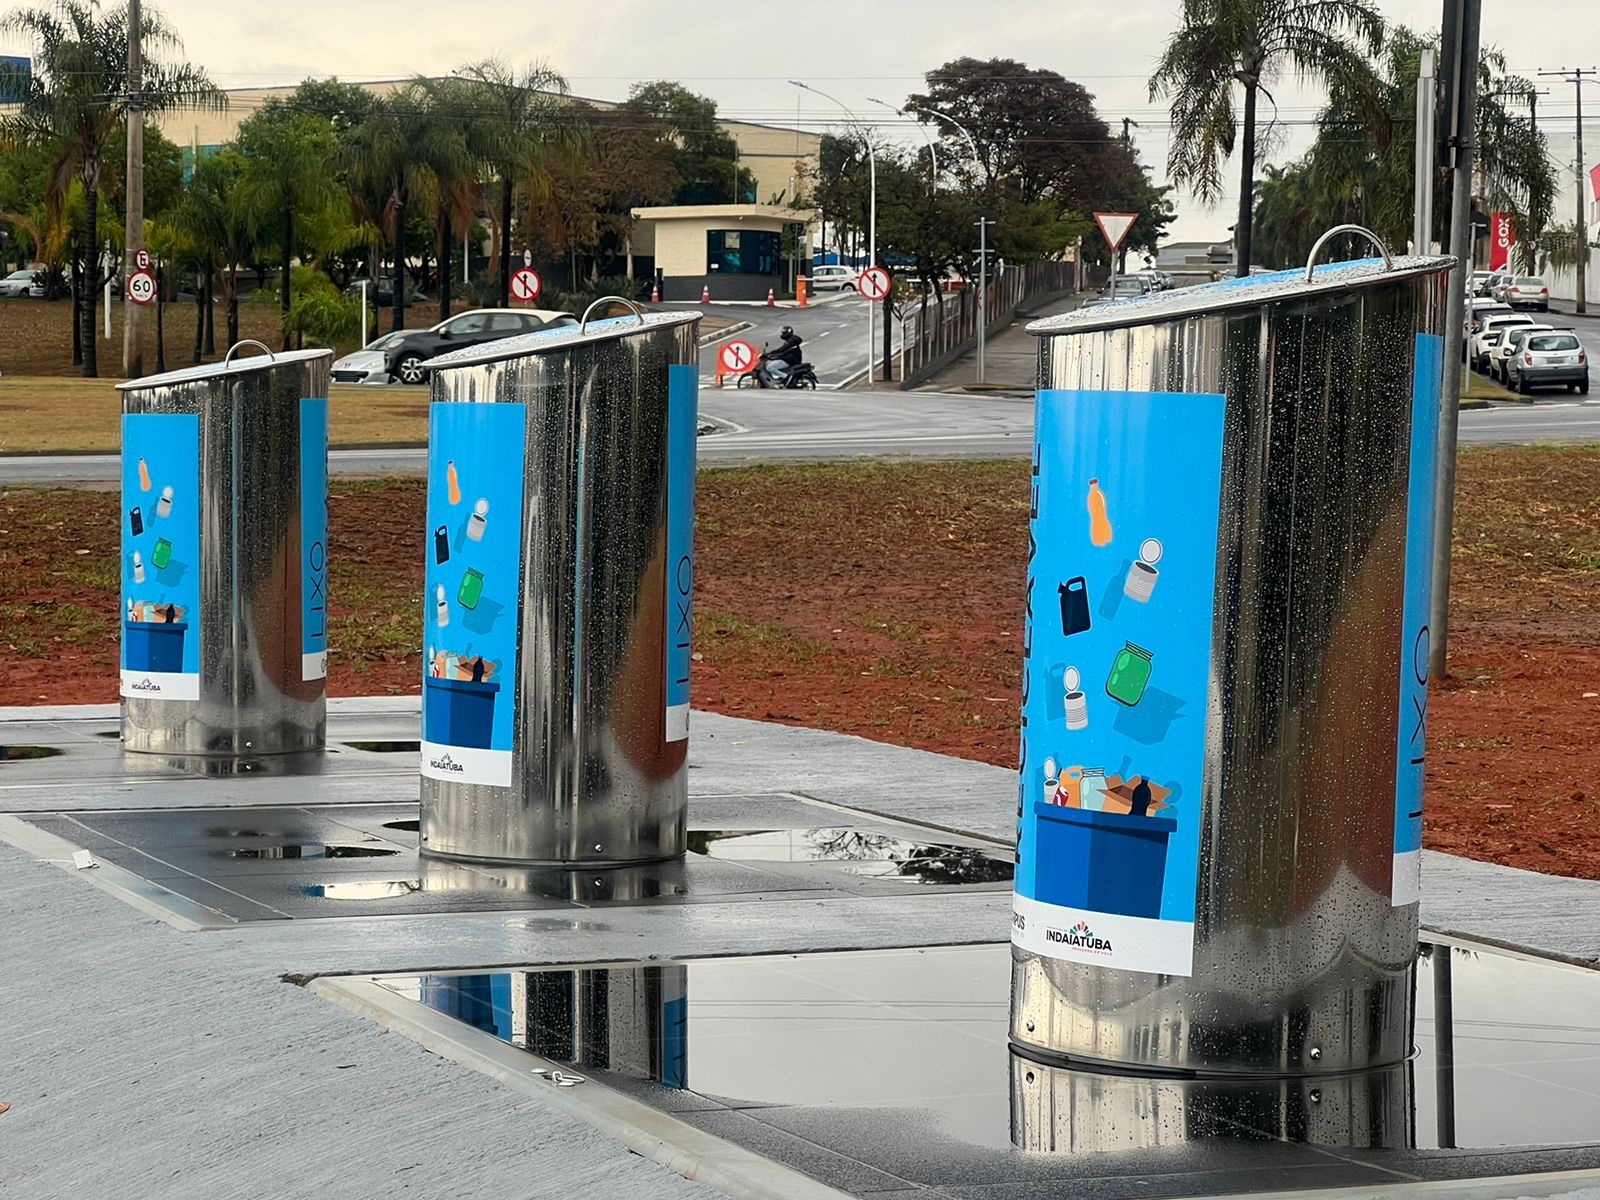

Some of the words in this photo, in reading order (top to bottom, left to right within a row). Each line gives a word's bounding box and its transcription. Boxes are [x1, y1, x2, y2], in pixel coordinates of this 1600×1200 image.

[133, 280, 150, 292] 60
[310, 541, 324, 637] LIXO
[676, 555, 692, 684] LIXO
[1046, 929, 1112, 951] INDAIATUBA
